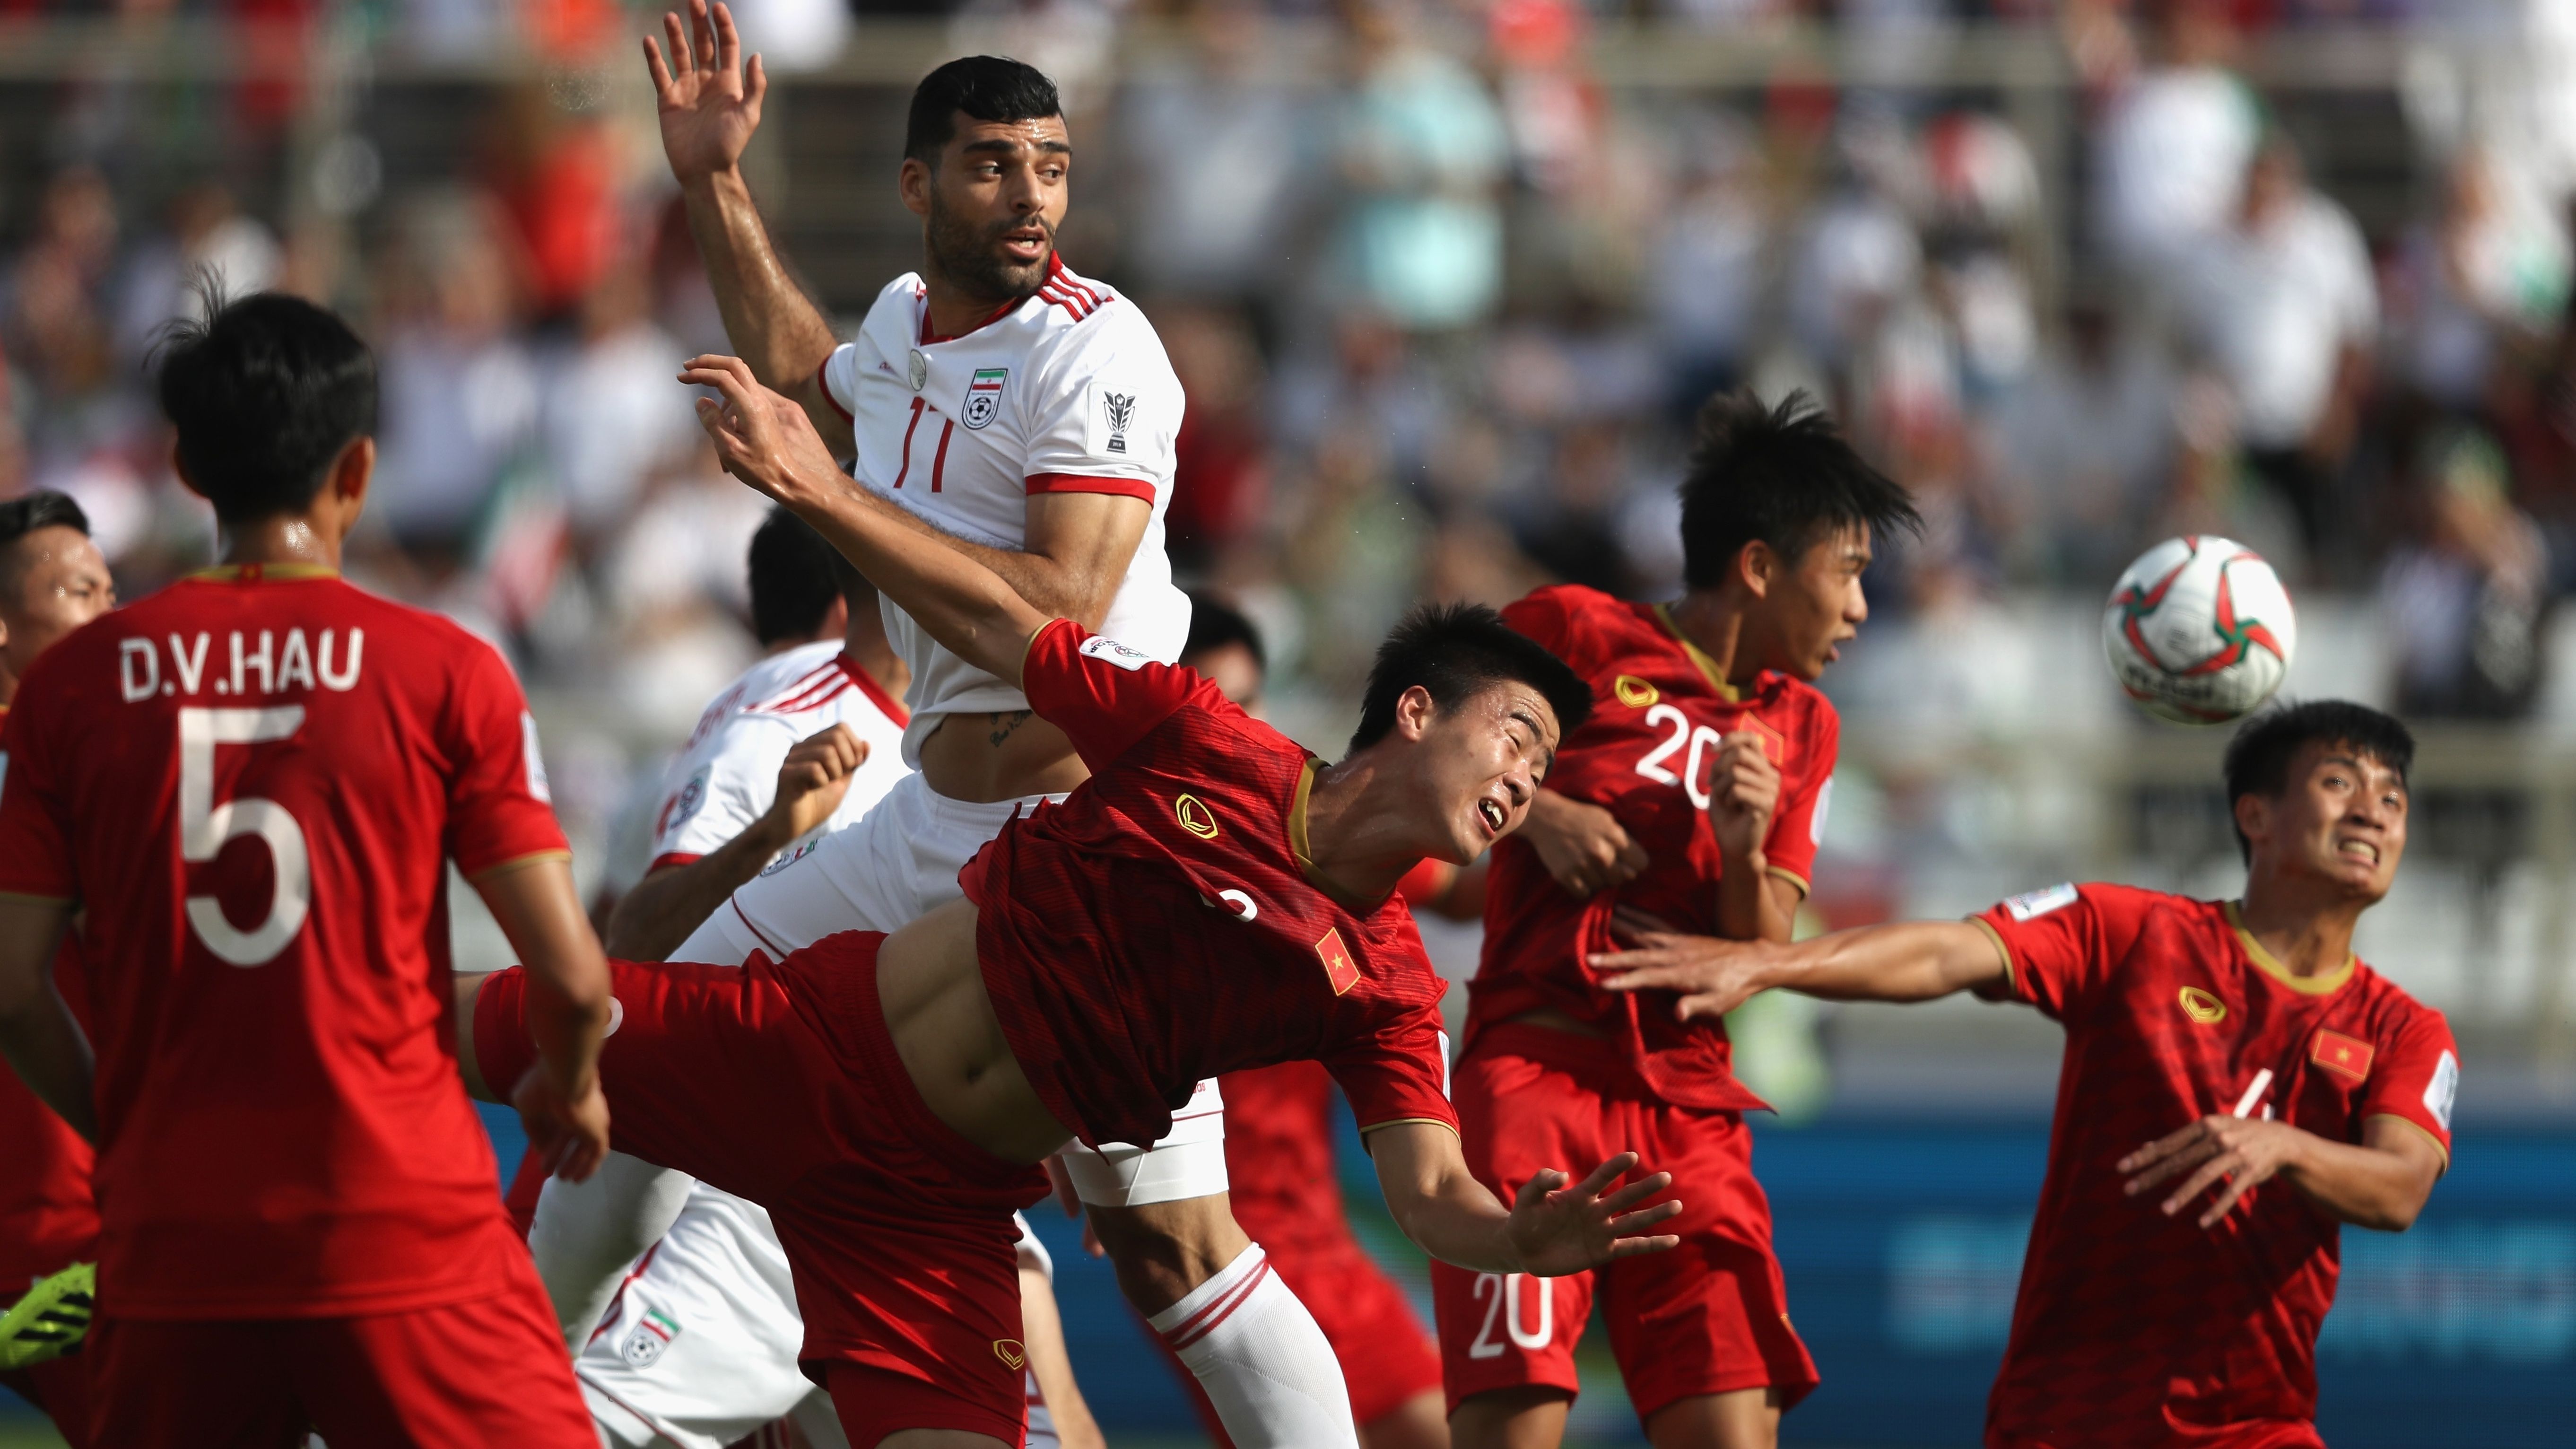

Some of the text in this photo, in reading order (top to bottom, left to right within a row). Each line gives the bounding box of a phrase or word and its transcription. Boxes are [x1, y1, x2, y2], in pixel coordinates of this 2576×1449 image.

[893, 396, 955, 493] 17
[119, 627, 363, 703] D.V.HAU
[178, 705, 310, 967] 5
[1469, 1273, 1553, 1359] 20
